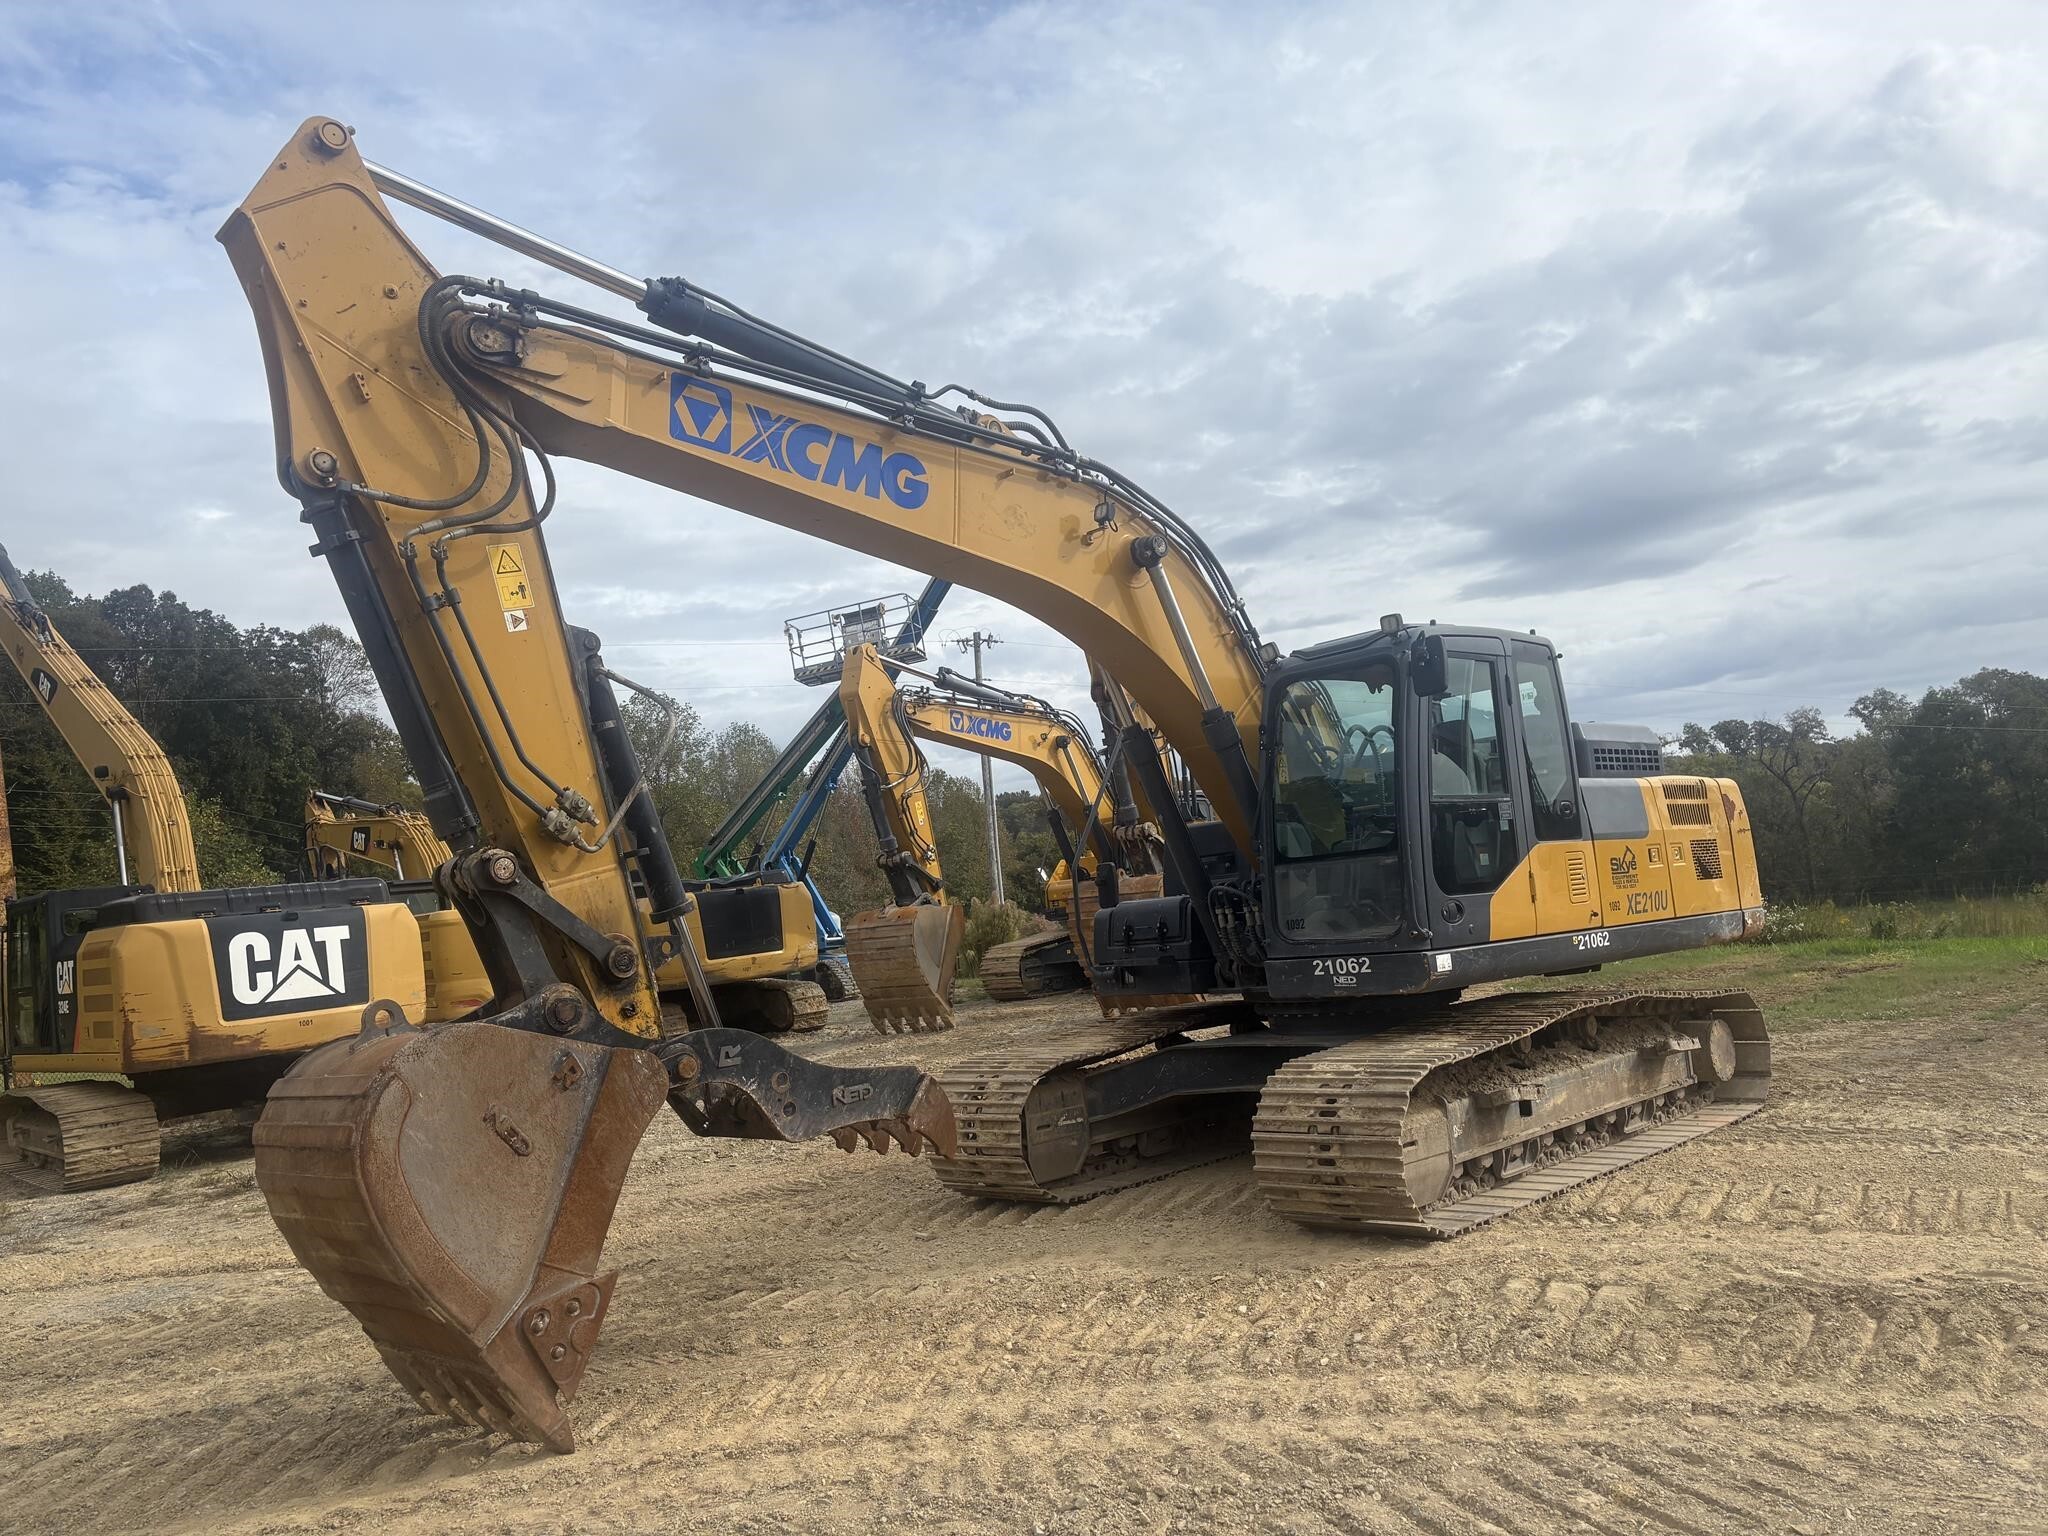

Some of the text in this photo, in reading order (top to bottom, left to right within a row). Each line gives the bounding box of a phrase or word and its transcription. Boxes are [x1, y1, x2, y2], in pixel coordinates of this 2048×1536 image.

[731, 402, 929, 510] XCMG
[39, 671, 51, 701] CAT
[965, 714, 1012, 742] XCMG
[353, 831, 366, 852] CAT
[1610, 853, 1637, 875] Skye
[1626, 889, 1668, 916] XE210U
[1286, 918, 1306, 931] 1092
[1578, 931, 1611, 950] 21062
[228, 925, 350, 1005] CAT
[1312, 957, 1372, 976] 21062
[56, 960, 74, 995] CAT
[1332, 976, 1357, 985] NED
